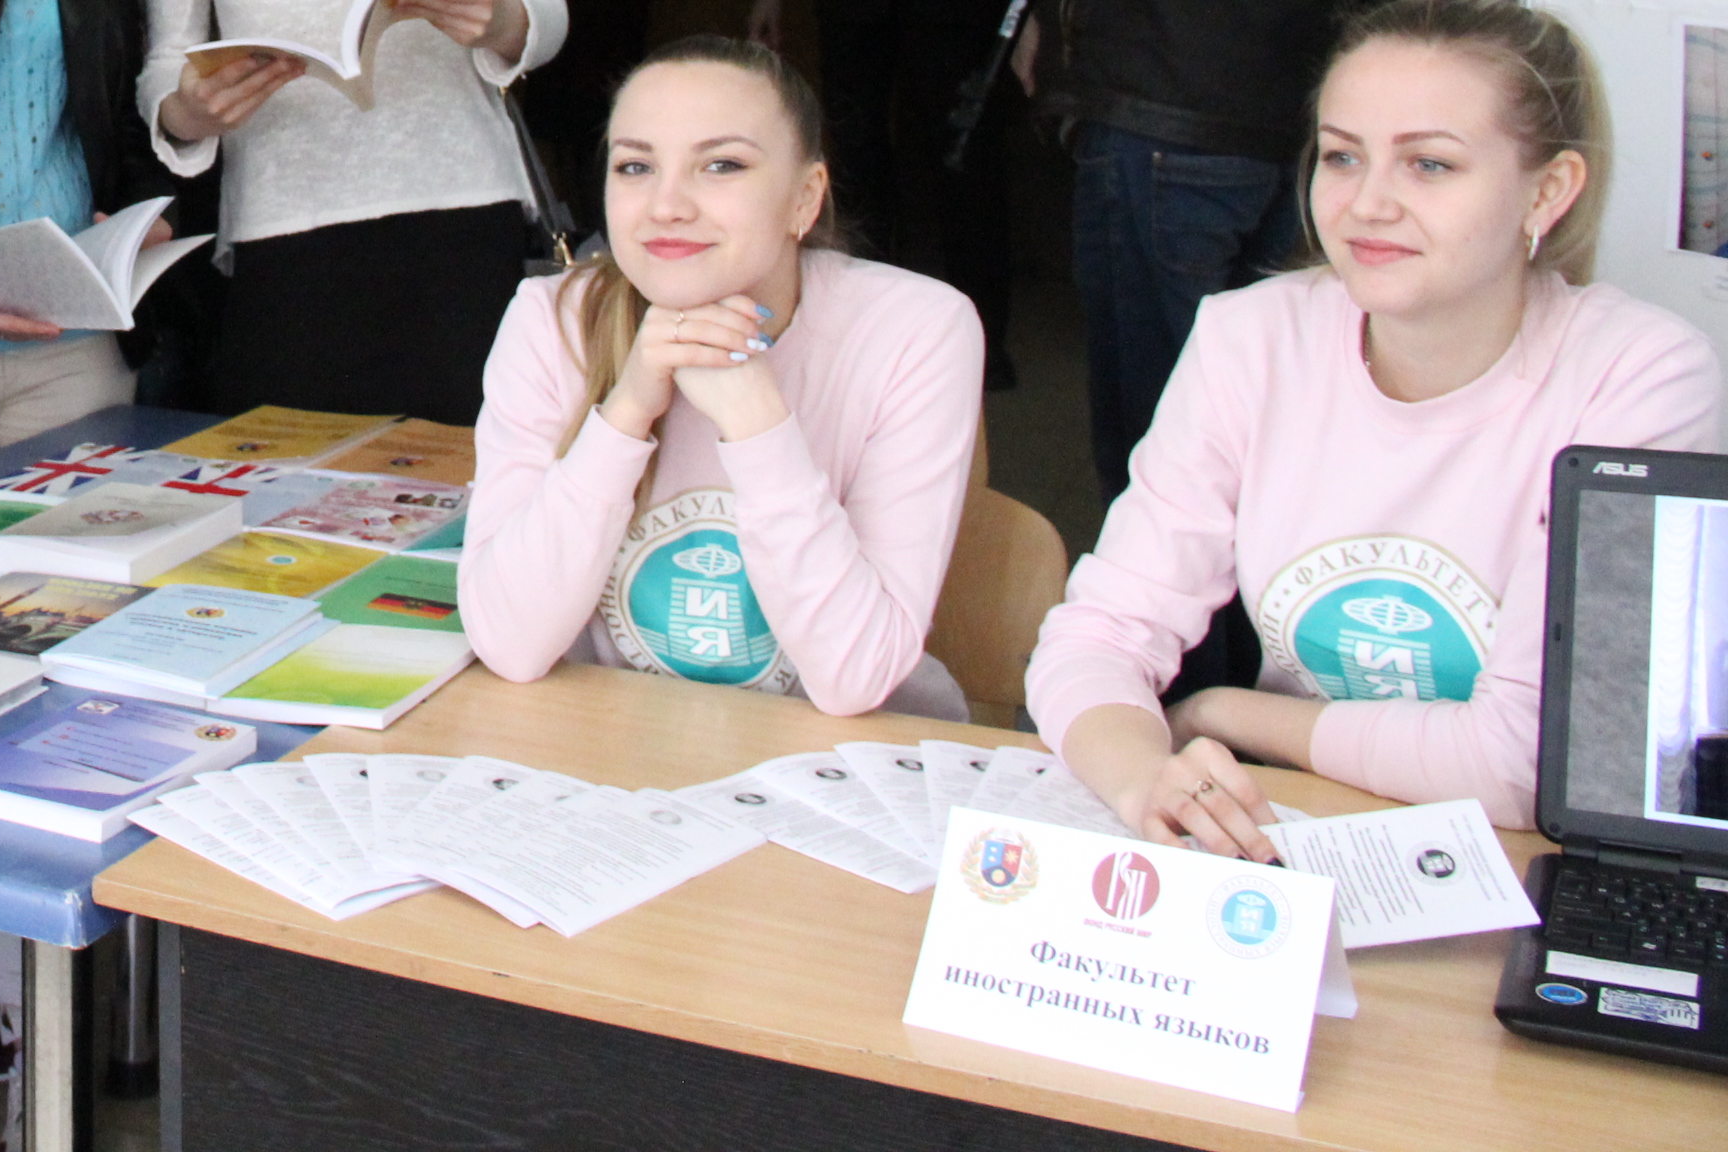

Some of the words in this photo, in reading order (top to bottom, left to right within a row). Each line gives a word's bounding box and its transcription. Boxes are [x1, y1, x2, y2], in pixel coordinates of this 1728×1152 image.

[1592, 461, 1650, 478] ASUS
[1294, 541, 1490, 613] ФАКУЛЬТЕТ
[1029, 938, 1197, 998] Факультет
[943, 964, 1145, 1026] иностранных
[1153, 1013, 1271, 1055] языков
